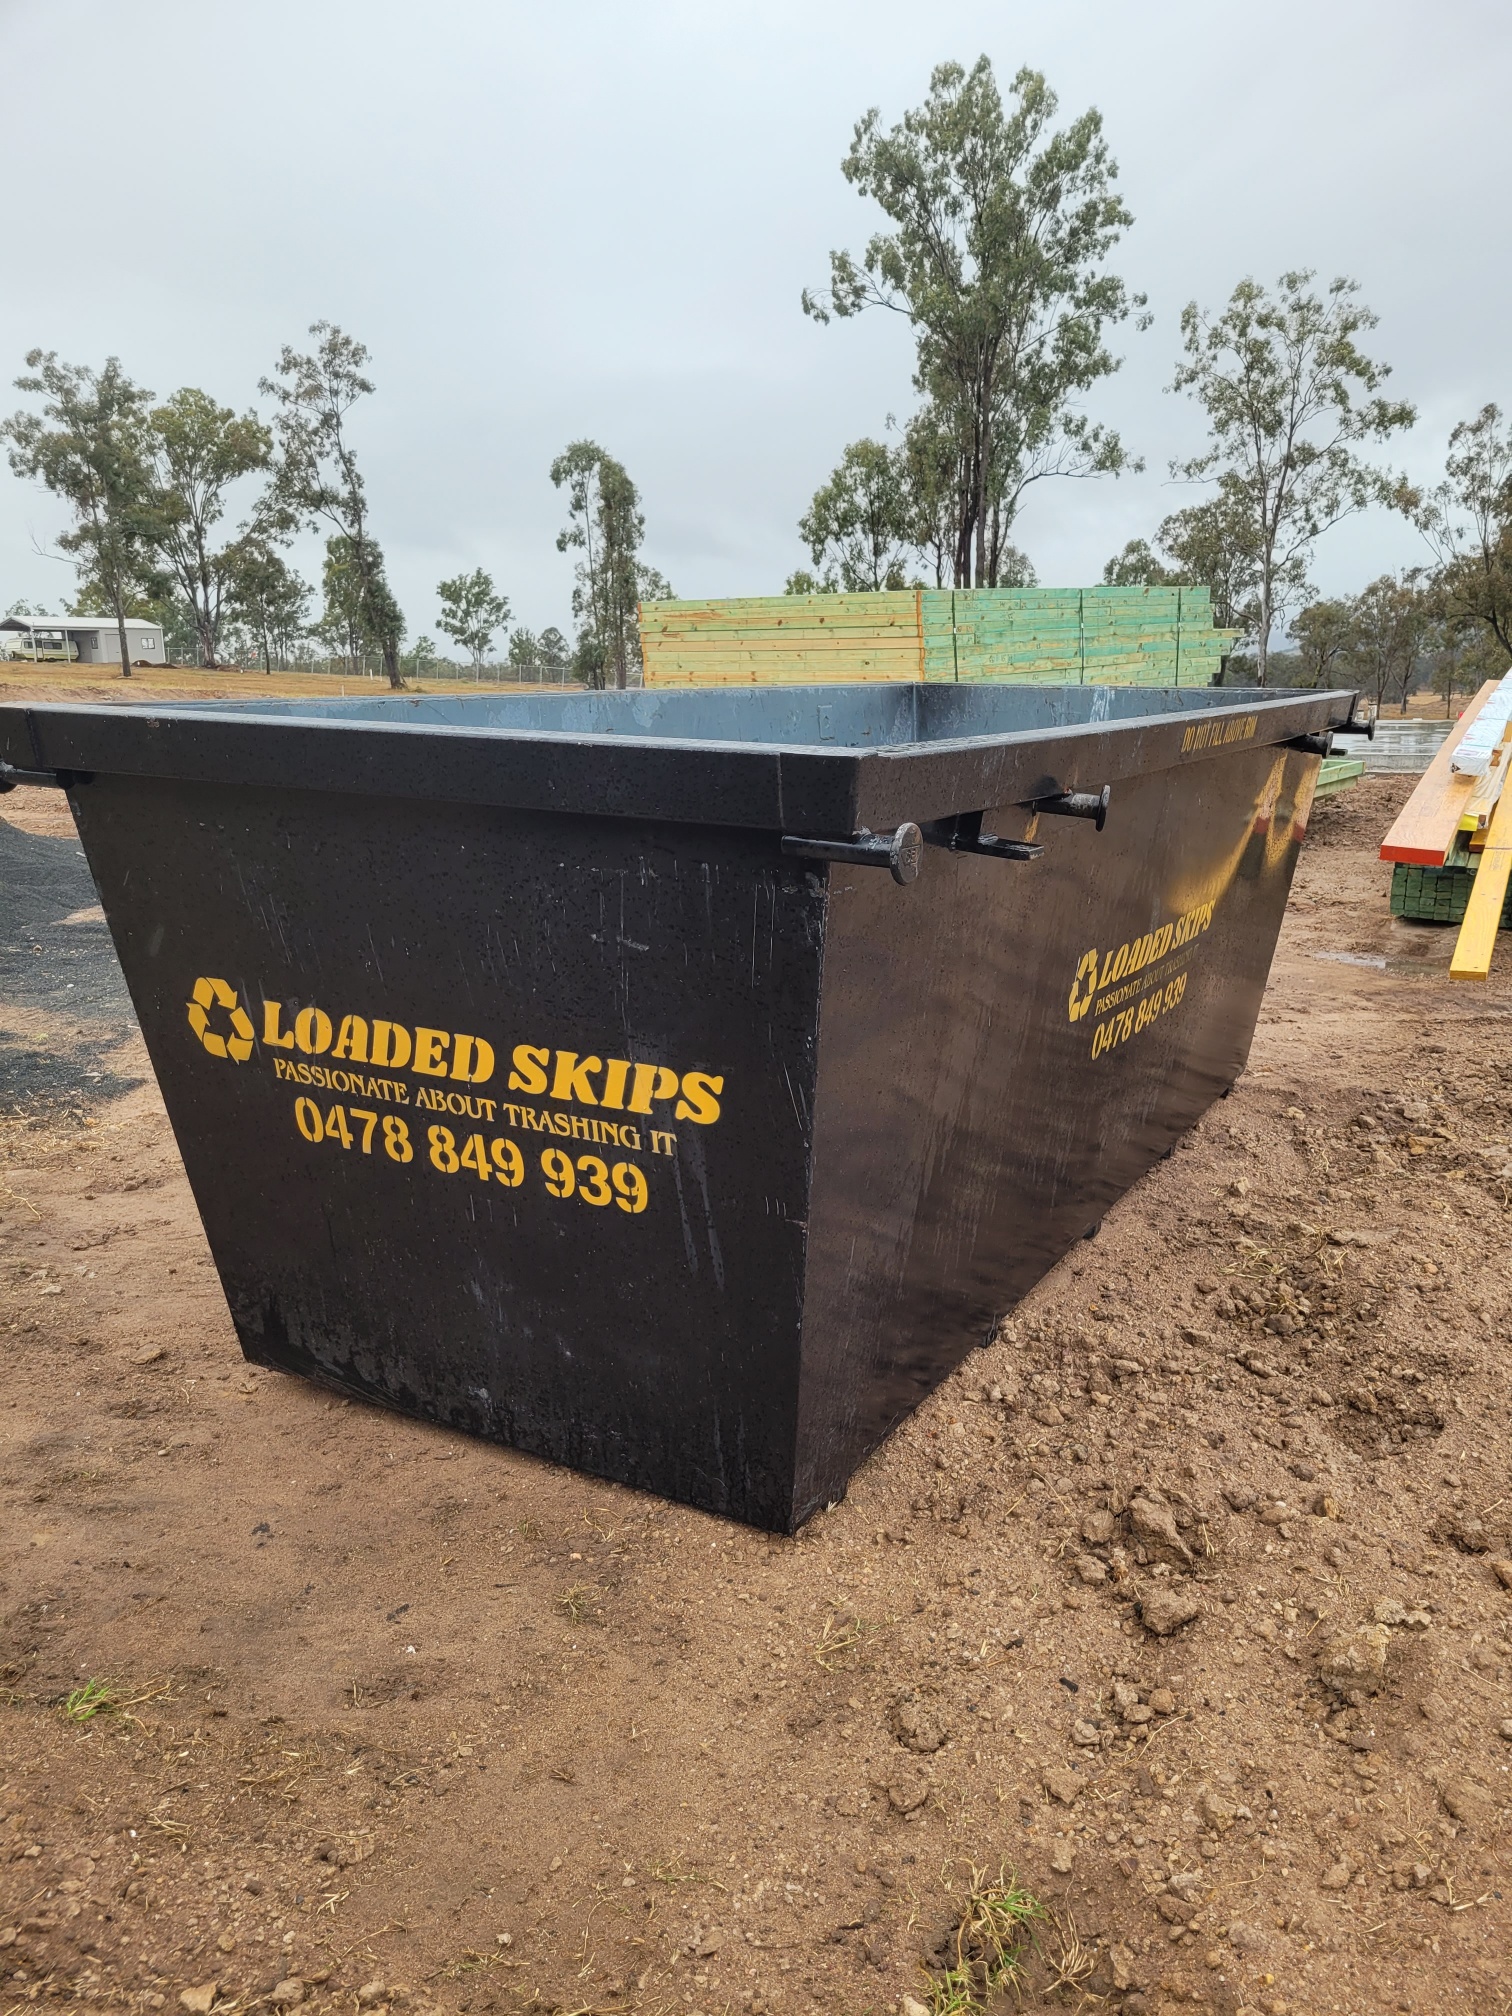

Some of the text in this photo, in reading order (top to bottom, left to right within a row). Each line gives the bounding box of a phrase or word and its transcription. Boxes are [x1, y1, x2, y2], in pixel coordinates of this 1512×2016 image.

[1181, 725, 1196, 753] DO
[1193, 721, 1212, 750] NOT
[1208, 721, 1225, 747] FILL
[1094, 977, 1142, 1016] PASSIONATE
[1141, 964, 1165, 990] ABOUT
[1097, 898, 1216, 990] LOADED SKIPS
[1092, 971, 1188, 1061] 0478 849 939
[263, 1001, 725, 1125] LOADED SKIPS
[274, 1058, 677, 1156] PASSIONATE ABOUT TRASHING IT
[294, 1096, 649, 1214] 0478 849 939
